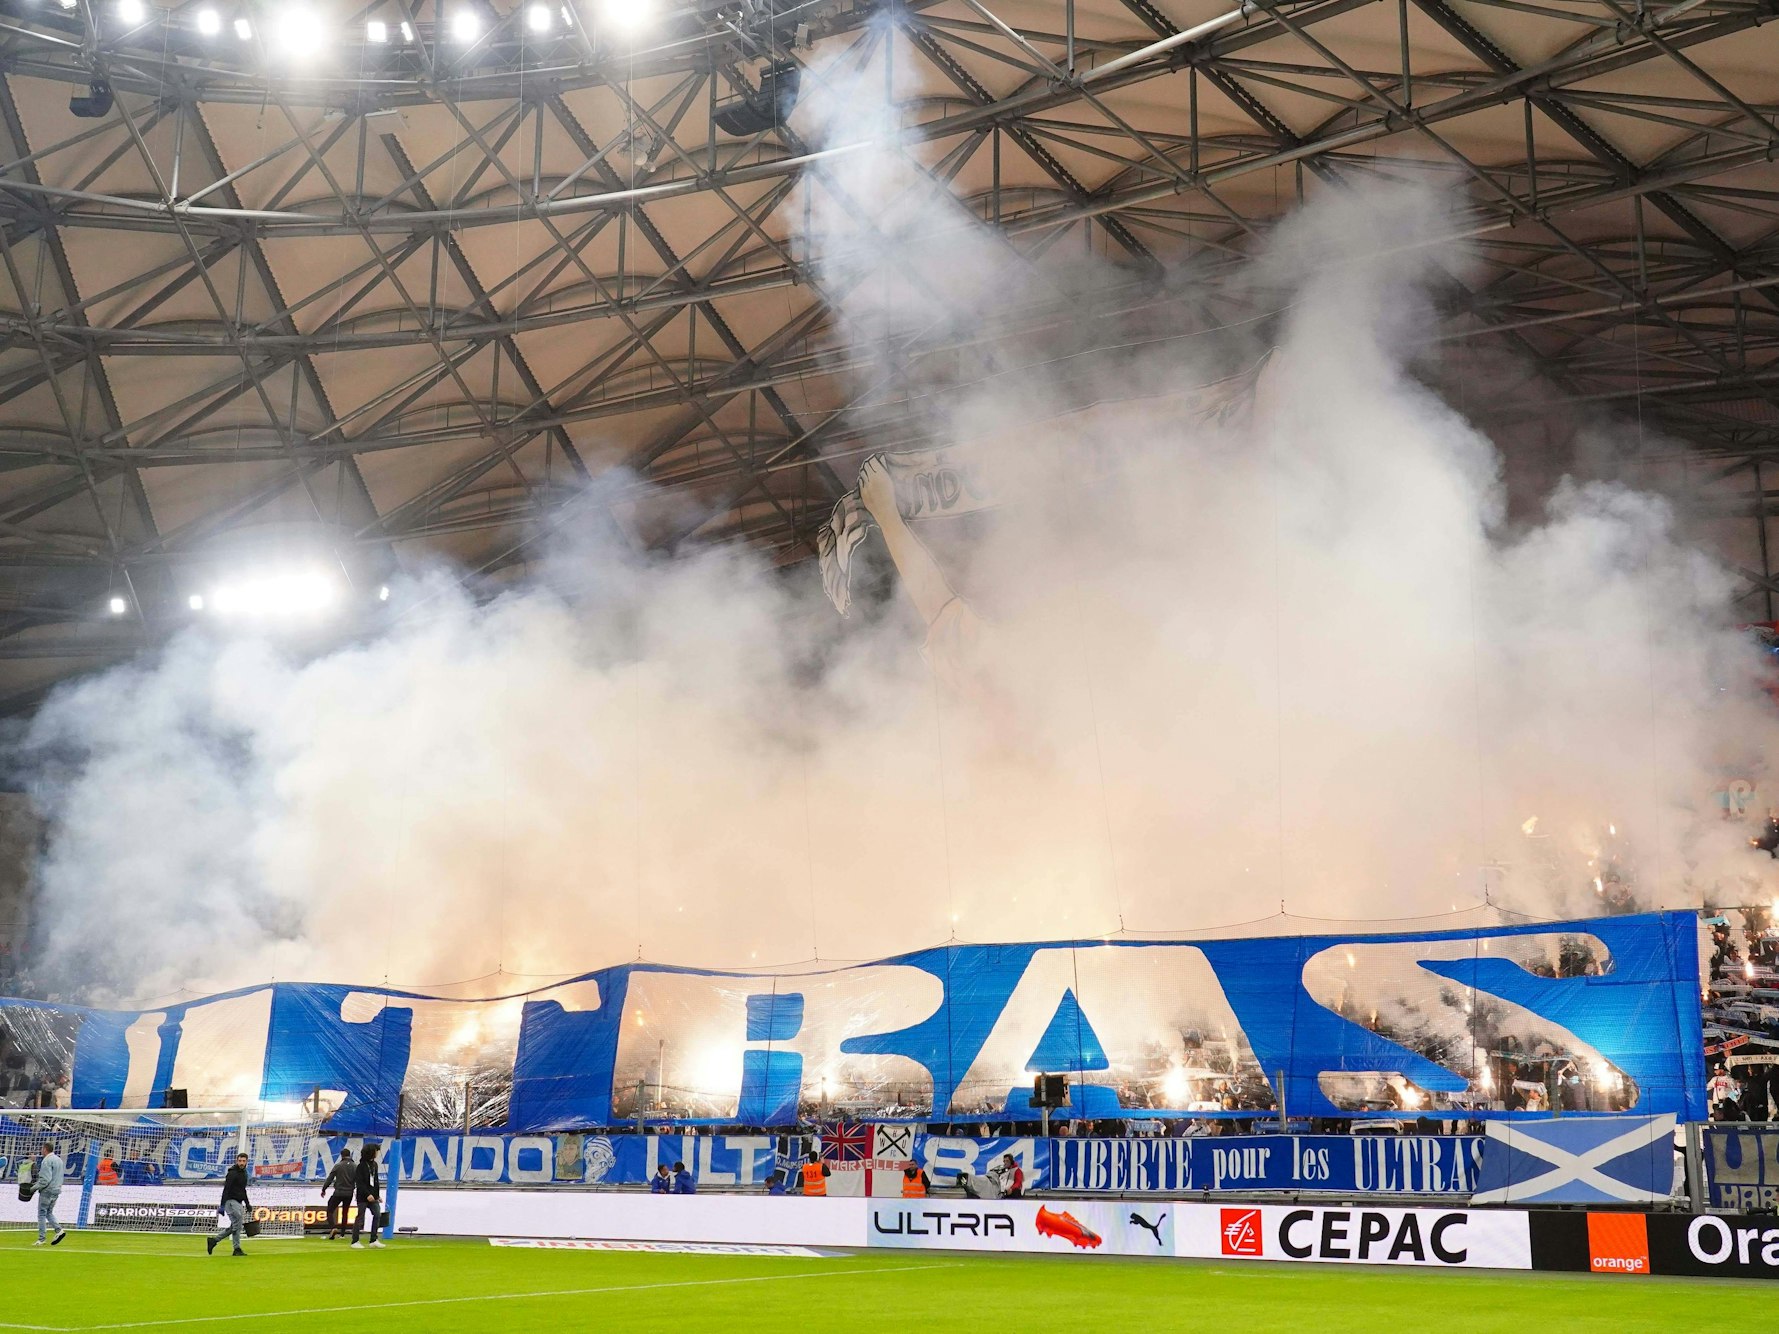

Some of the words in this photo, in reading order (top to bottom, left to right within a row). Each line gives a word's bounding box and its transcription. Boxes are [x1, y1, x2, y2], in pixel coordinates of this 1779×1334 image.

[178, 1136, 553, 1183] COMMANDO
[923, 1137, 1042, 1191] 84
[829, 1159, 900, 1171] MARSEILLE
[1057, 1139, 1193, 1190] LIBERTE
[1212, 1147, 1271, 1190] pour
[1292, 1137, 1330, 1181] les
[1352, 1137, 1486, 1192] ULTRAS
[109, 1207, 166, 1217] PARIONS
[168, 1208, 215, 1217] SPORT
[253, 1206, 328, 1224] Orange
[874, 1211, 1015, 1237] ULTRA
[1278, 1209, 1468, 1264] CEPAC
[537, 1240, 795, 1255] INTERSPORT
[1593, 1256, 1644, 1272] orange
